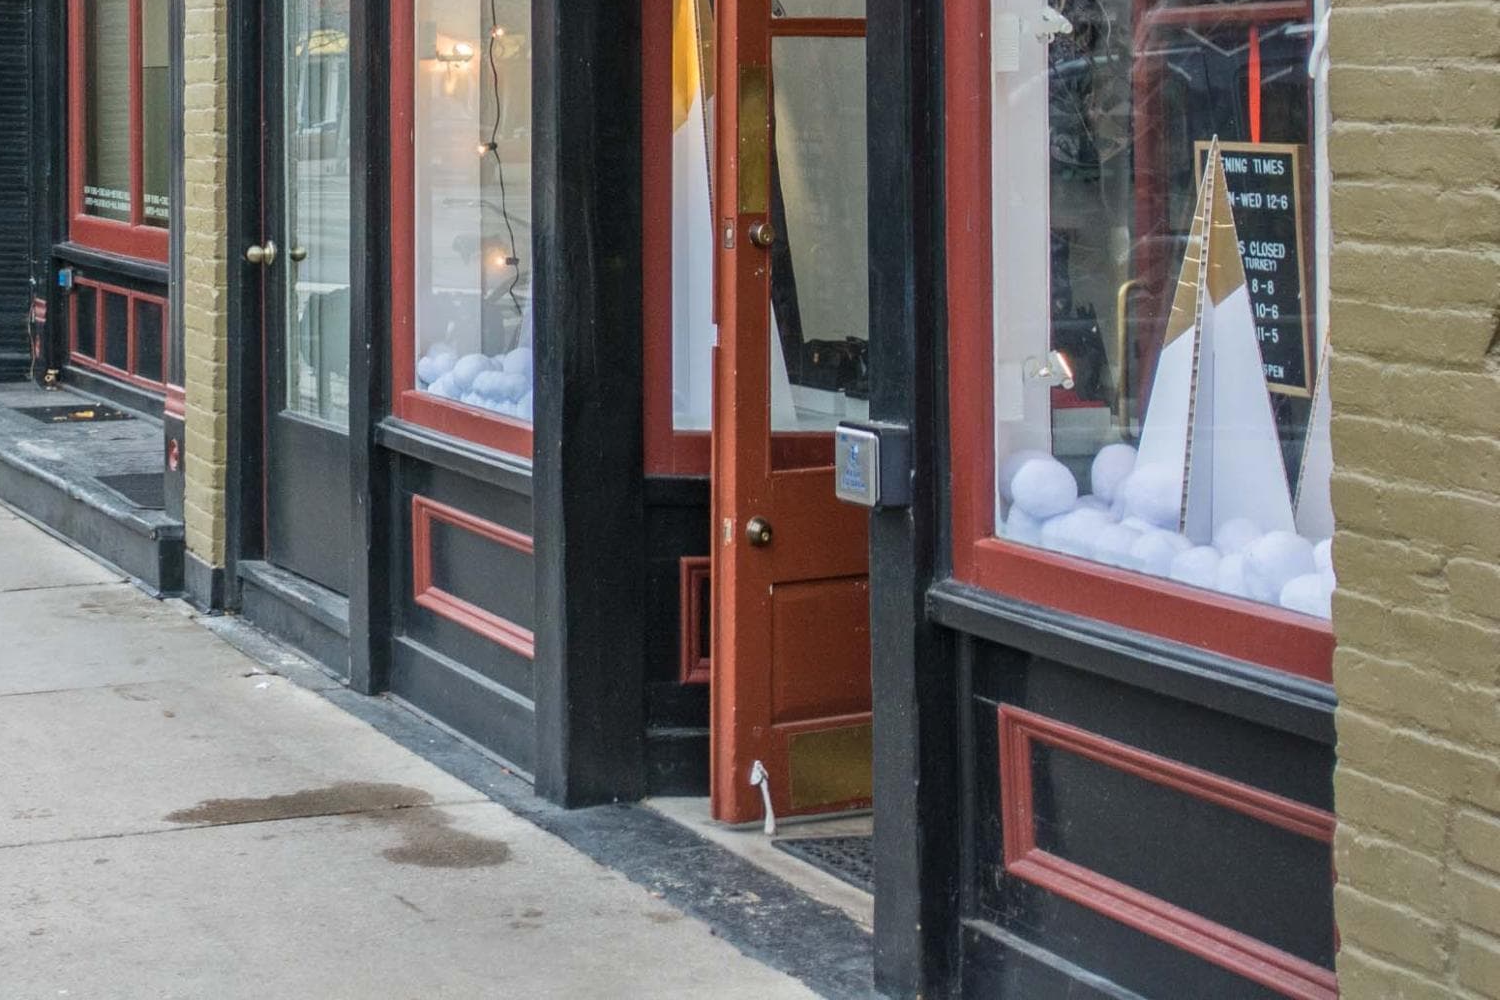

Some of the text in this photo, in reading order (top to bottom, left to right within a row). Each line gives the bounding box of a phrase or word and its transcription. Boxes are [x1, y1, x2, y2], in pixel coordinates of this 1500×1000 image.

[1220, 157, 1285, 175] NING TIMES
[1228, 191, 1289, 210] N-WED 12-6
[1249, 240, 1286, 259] CLOSED
